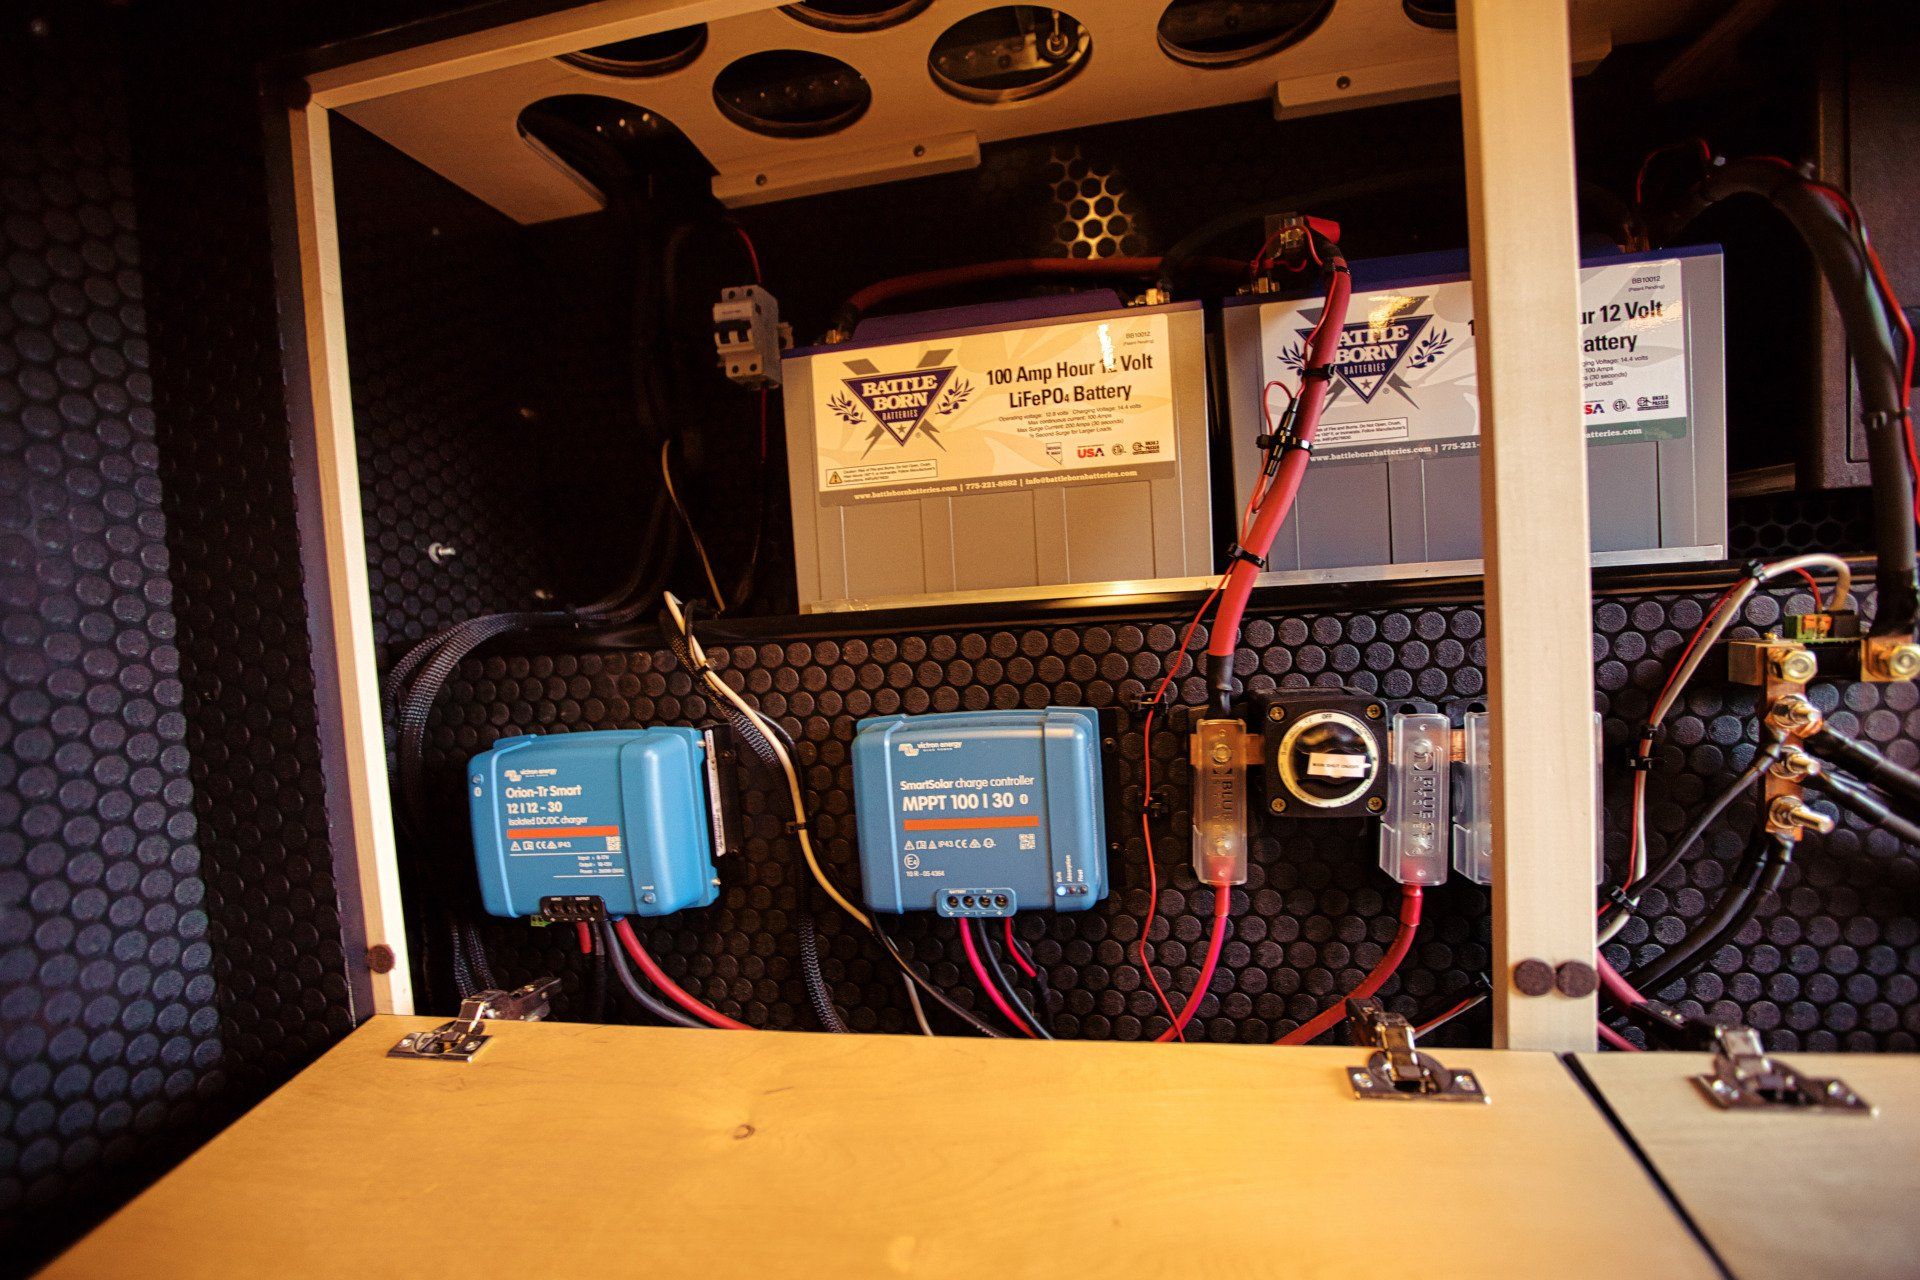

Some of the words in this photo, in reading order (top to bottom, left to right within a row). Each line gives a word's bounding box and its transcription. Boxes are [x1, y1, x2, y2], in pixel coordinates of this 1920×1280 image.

[1600, 304, 1621, 323] 12
[1624, 299, 1664, 320] Volt
[1338, 324, 1410, 347] ATTLE
[1583, 335, 1638, 353] attery
[1334, 343, 1399, 365] BORN
[986, 368, 1012, 386] 100
[1016, 366, 1053, 384] Amp
[1056, 361, 1095, 378] Hour
[1120, 353, 1153, 371] Volt
[1343, 363, 1387, 375] BATTERIES
[860, 374, 938, 397] BATTLE
[1074, 384, 1132, 402] Battery
[872, 391, 929, 412] BORN
[1584, 403, 1605, 415] SA
[881, 409, 919, 421] BATTERIES
[1077, 447, 1105, 458] USA
[1310, 444, 1433, 462] www.battlebornbatteries.com
[1440, 441, 1481, 451] 775-221-
[853, 484, 958, 500] www.battlebornbatteries.com
[505, 786, 548, 798] Orion-Tr
[548, 784, 583, 797] Smart
[900, 778, 954, 791] SmartSolar
[955, 777, 989, 790] charge
[989, 774, 1035, 787] controller
[547, 800, 563, 813] 30
[902, 794, 947, 812] MPPT
[949, 793, 980, 810] 100
[991, 792, 1015, 809] 30
